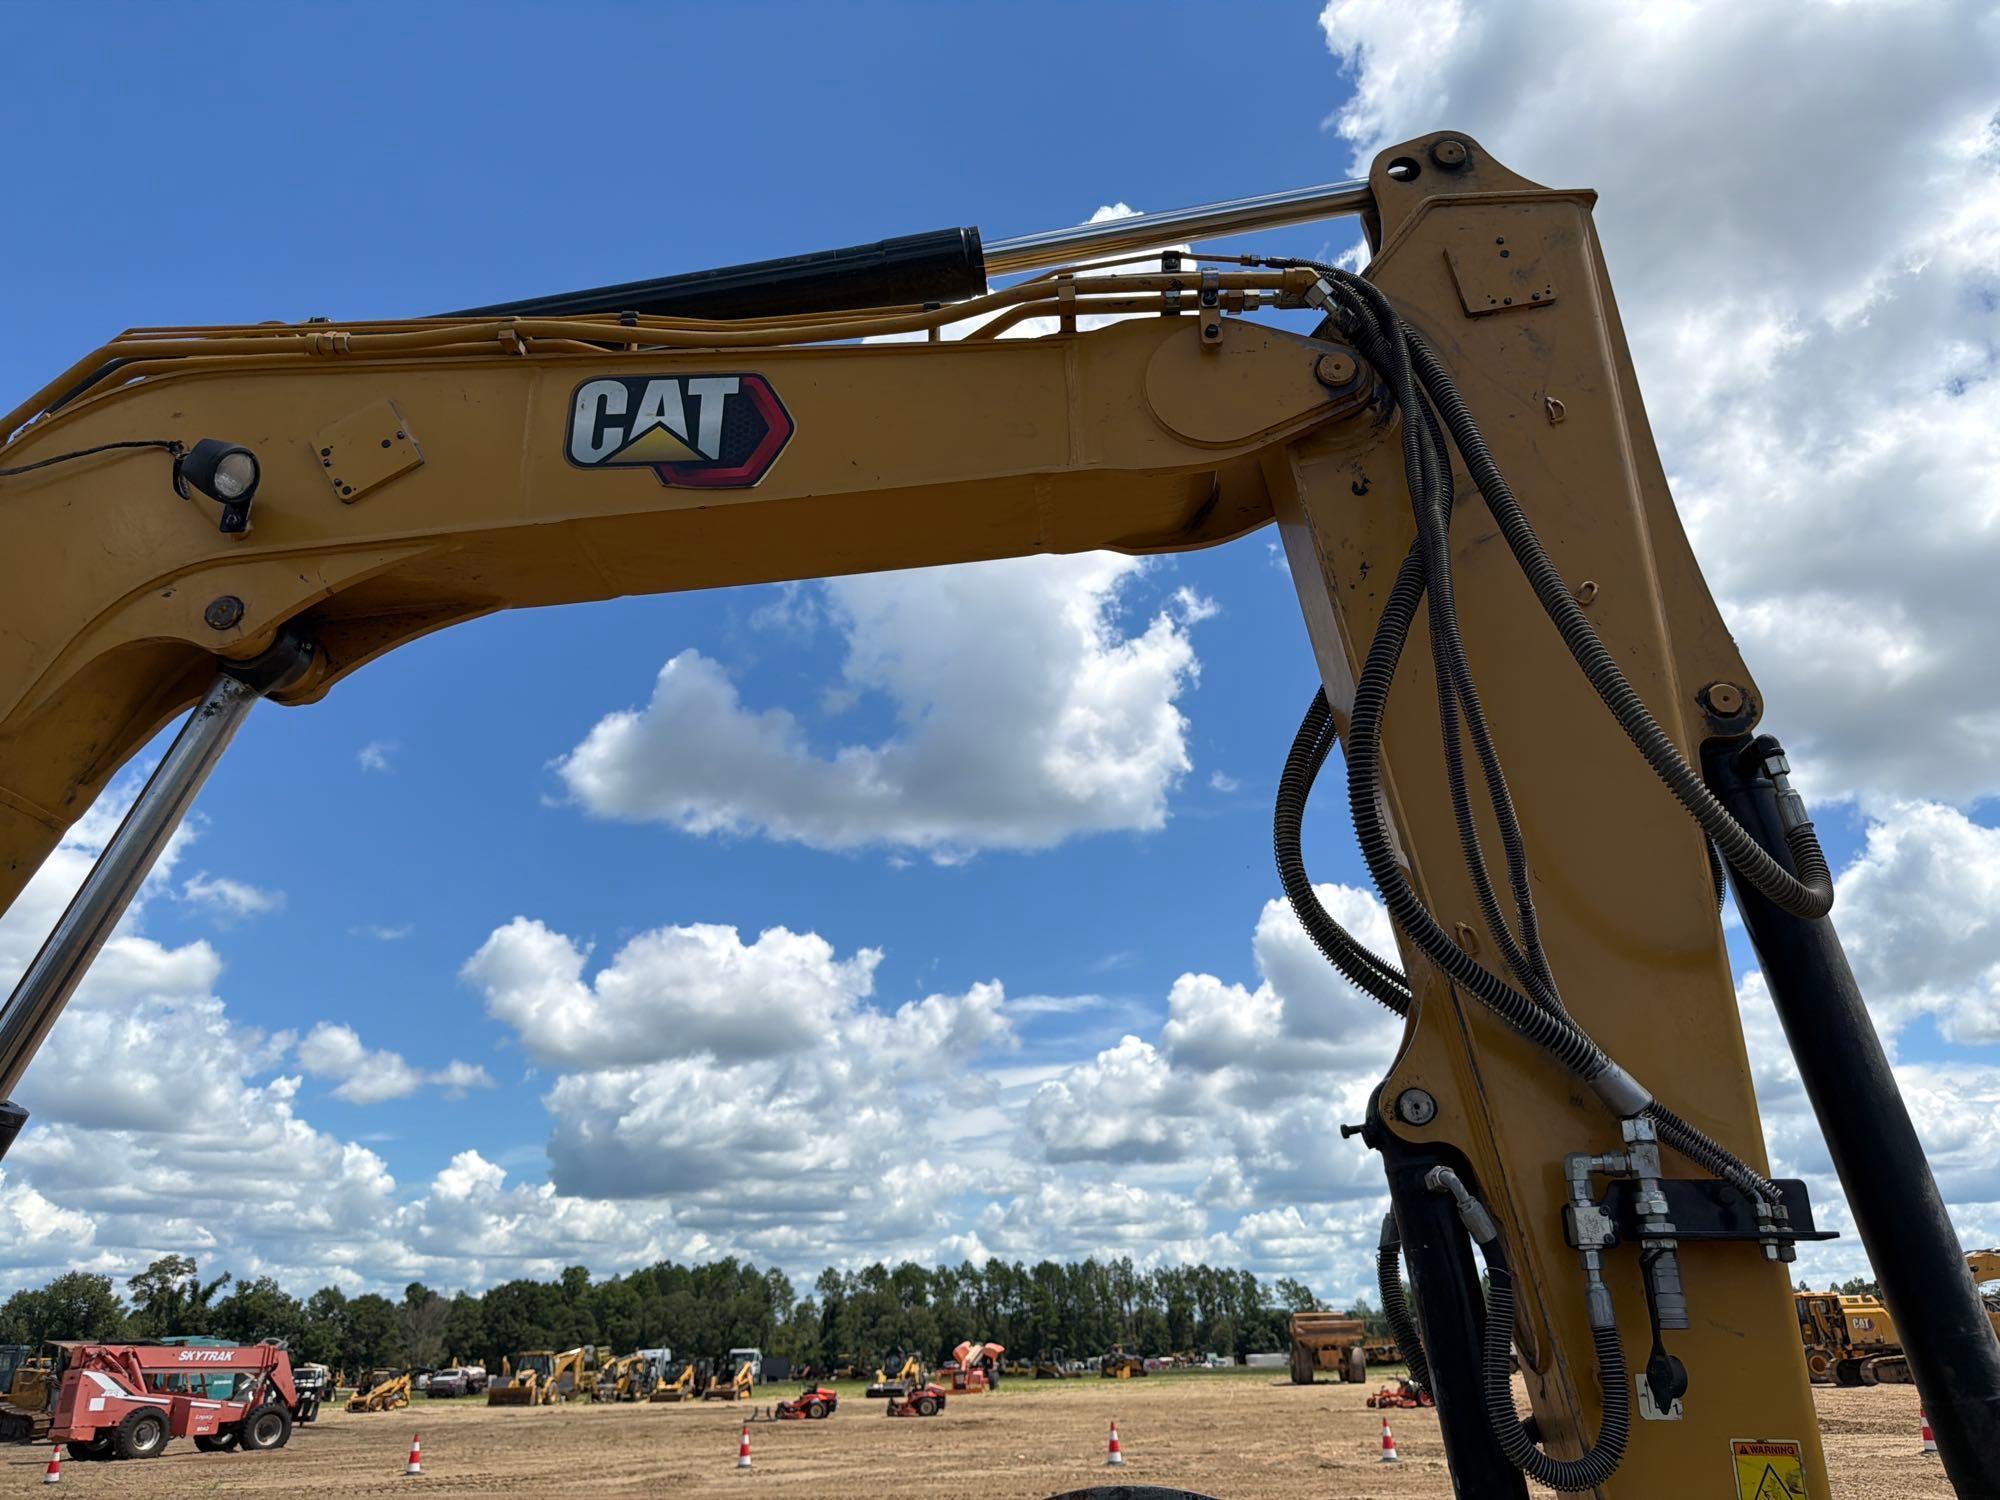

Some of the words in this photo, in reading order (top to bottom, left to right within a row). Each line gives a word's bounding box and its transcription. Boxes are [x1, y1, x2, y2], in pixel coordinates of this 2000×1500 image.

[571, 377, 740, 464] CAT
[1852, 1318, 1870, 1329] CAT
[178, 1350, 235, 1361] SKYTRAK
[1749, 1445, 1795, 1455] WARNING
